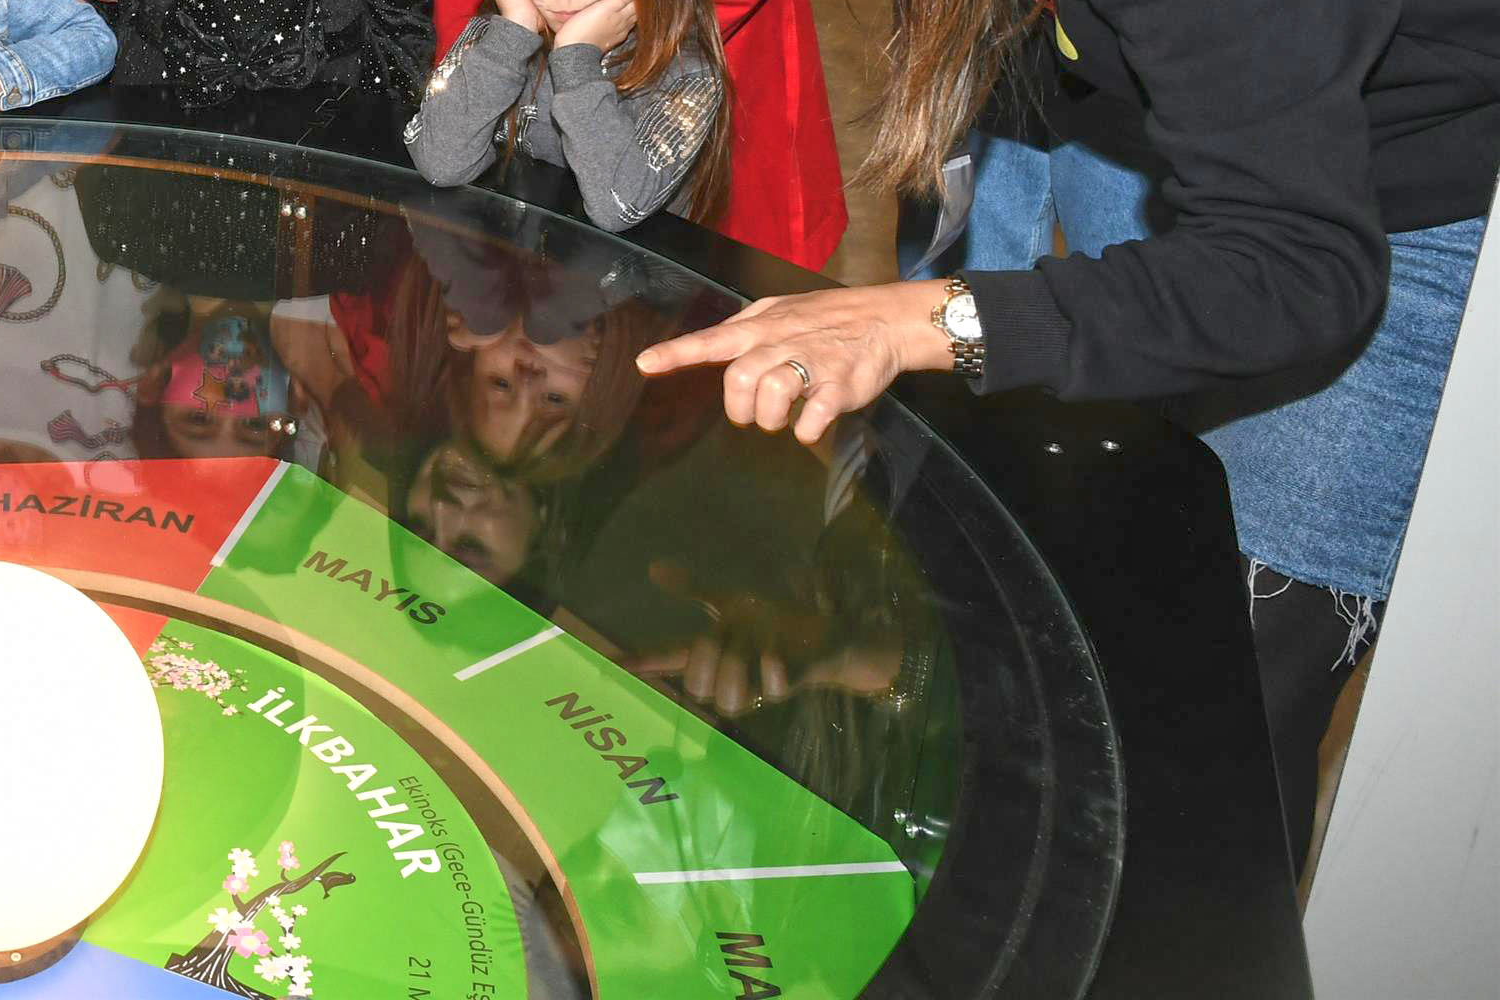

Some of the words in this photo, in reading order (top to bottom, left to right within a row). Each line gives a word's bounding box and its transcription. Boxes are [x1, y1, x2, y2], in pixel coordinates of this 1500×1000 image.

[303, 550, 446, 625] MAYIS
[246, 686, 442, 879] İLKBAHAR
[544, 691, 680, 806] NİSAN
[398, 775, 449, 838] Ekinoks
[435, 841, 494, 977] (Gece-Gündüz
[408, 956, 432, 979] 21
